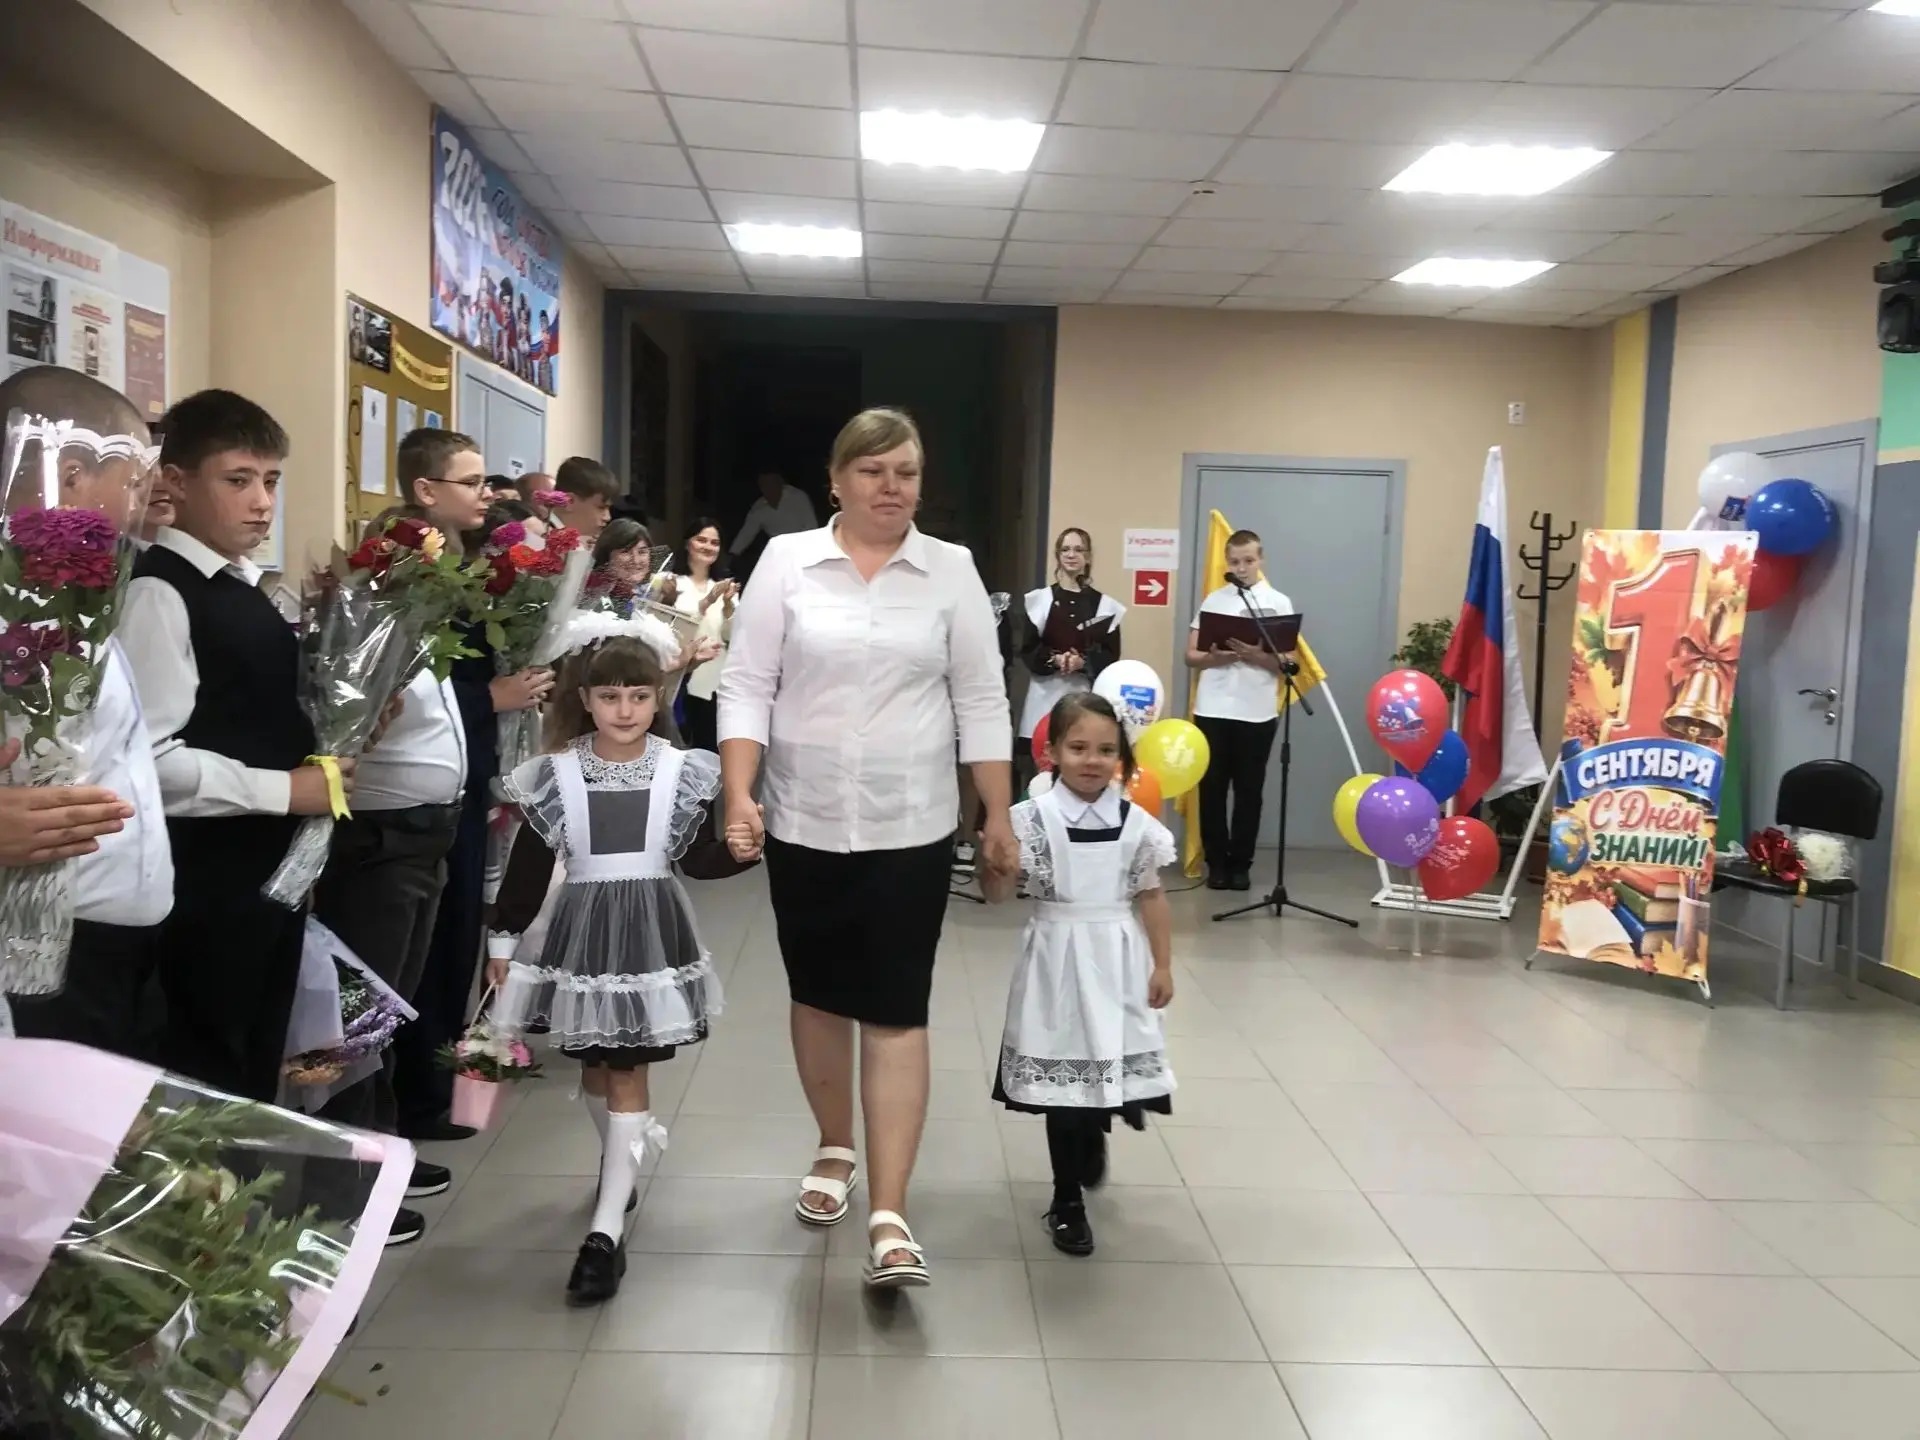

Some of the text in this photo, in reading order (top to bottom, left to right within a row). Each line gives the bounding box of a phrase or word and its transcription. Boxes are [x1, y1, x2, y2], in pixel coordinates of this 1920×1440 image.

[1604, 548, 1701, 742] 1
[1577, 747, 1717, 789] СЕНТЯБРЯ
[1589, 790, 1701, 833] С Днём
[1590, 832, 1710, 868] ЗНАНИЙ!
